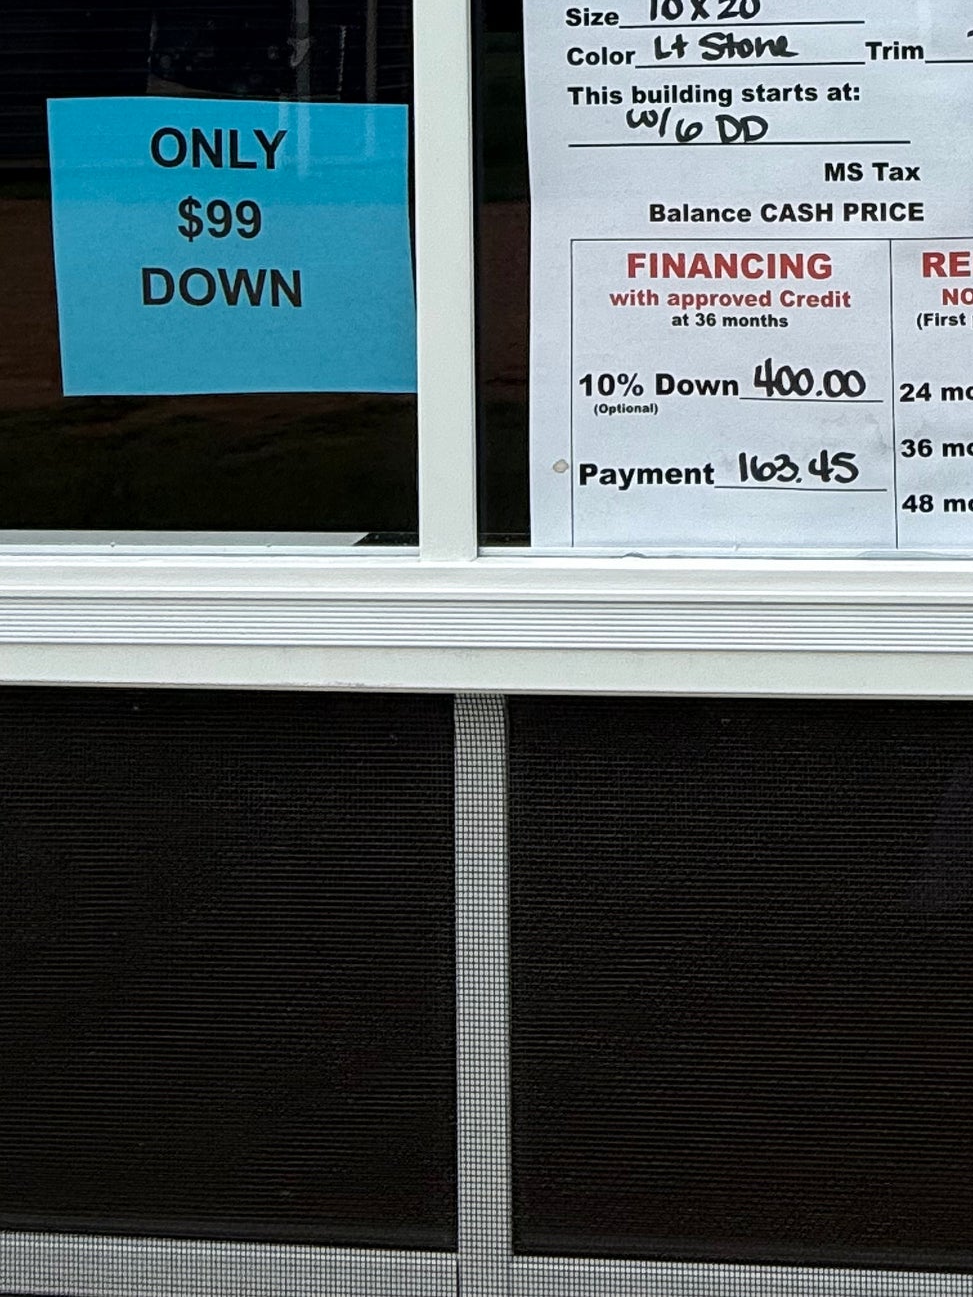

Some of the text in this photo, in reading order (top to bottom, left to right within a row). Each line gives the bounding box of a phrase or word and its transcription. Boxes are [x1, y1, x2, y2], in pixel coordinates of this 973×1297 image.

[565, 8, 619, 26] Size
[567, 47, 636, 65] Color
[654, 34, 689, 60] Lt
[698, 32, 799, 61] Stone
[865, 41, 924, 60] Trim
[568, 86, 622, 104] This
[632, 85, 732, 107] building
[741, 83, 818, 102] starts
[827, 82, 861, 101] at:
[716, 115, 769, 143] DD
[150, 127, 287, 169] ONLY
[825, 163, 863, 181] MS
[872, 162, 922, 181] Tax
[178, 196, 262, 242] $99
[649, 203, 751, 222] Balance
[760, 203, 833, 222] CASH
[843, 202, 924, 221] PRICE
[627, 253, 832, 279] FINANCING
[142, 267, 302, 307] DOWN
[610, 290, 851, 309] with approved Credit
[671, 313, 789, 328] at 36 months
[916, 312, 966, 329] (First
[579, 358, 866, 398] 10% Down 400.00
[900, 382, 932, 401] 24
[594, 403, 658, 416] (Optional)
[901, 439, 933, 457] 36
[579, 450, 860, 490] Payment 163.45
[902, 494, 933, 513] 48
